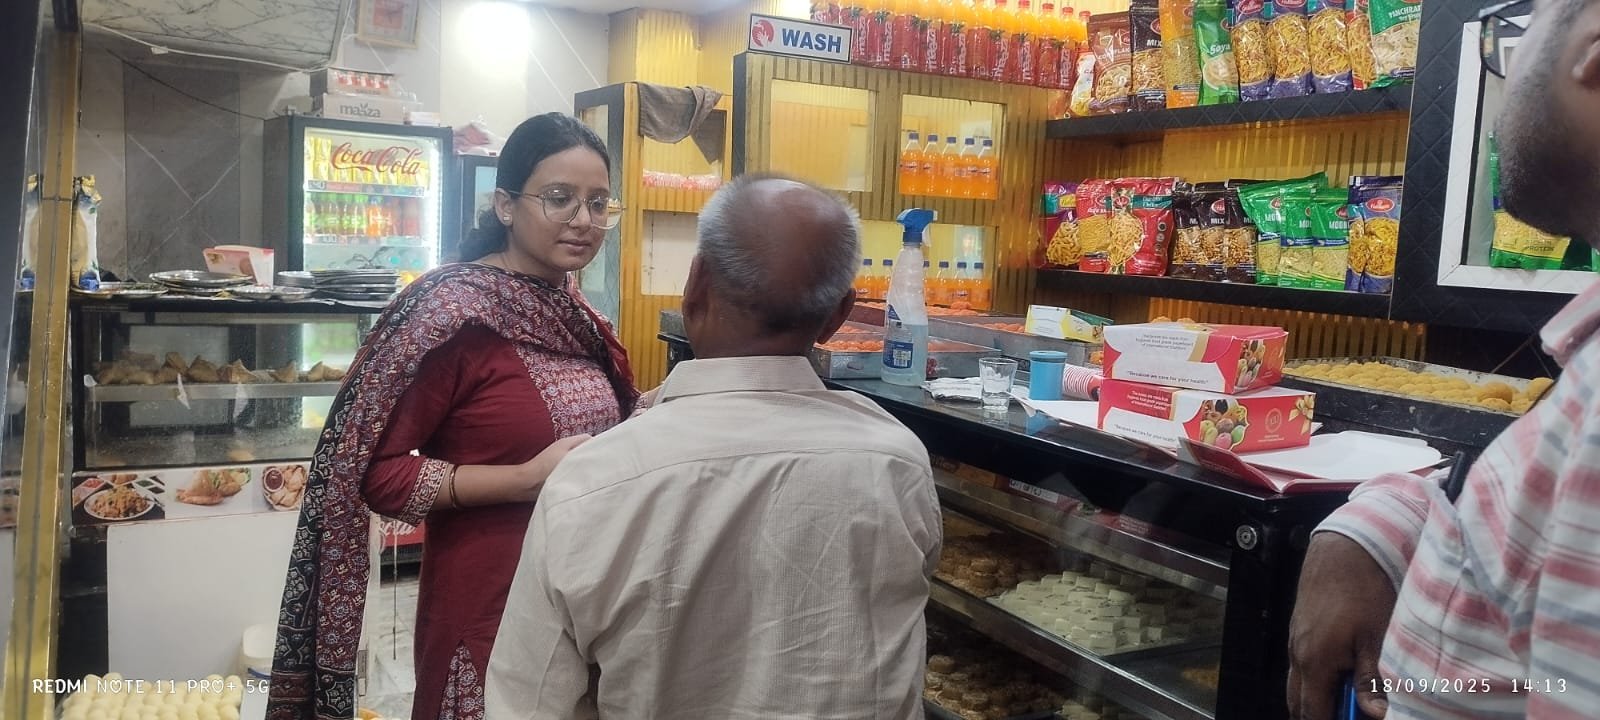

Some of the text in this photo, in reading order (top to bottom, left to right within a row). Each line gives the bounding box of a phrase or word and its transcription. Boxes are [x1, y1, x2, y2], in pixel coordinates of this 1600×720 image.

[782, 28, 842, 53] WASH
[883, 21, 893, 62] maaza
[926, 28, 938, 73] maaza
[1209, 44, 1231, 56] Soya
[1060, 48, 1071, 87] maaza
[340, 103, 381, 118] maaza
